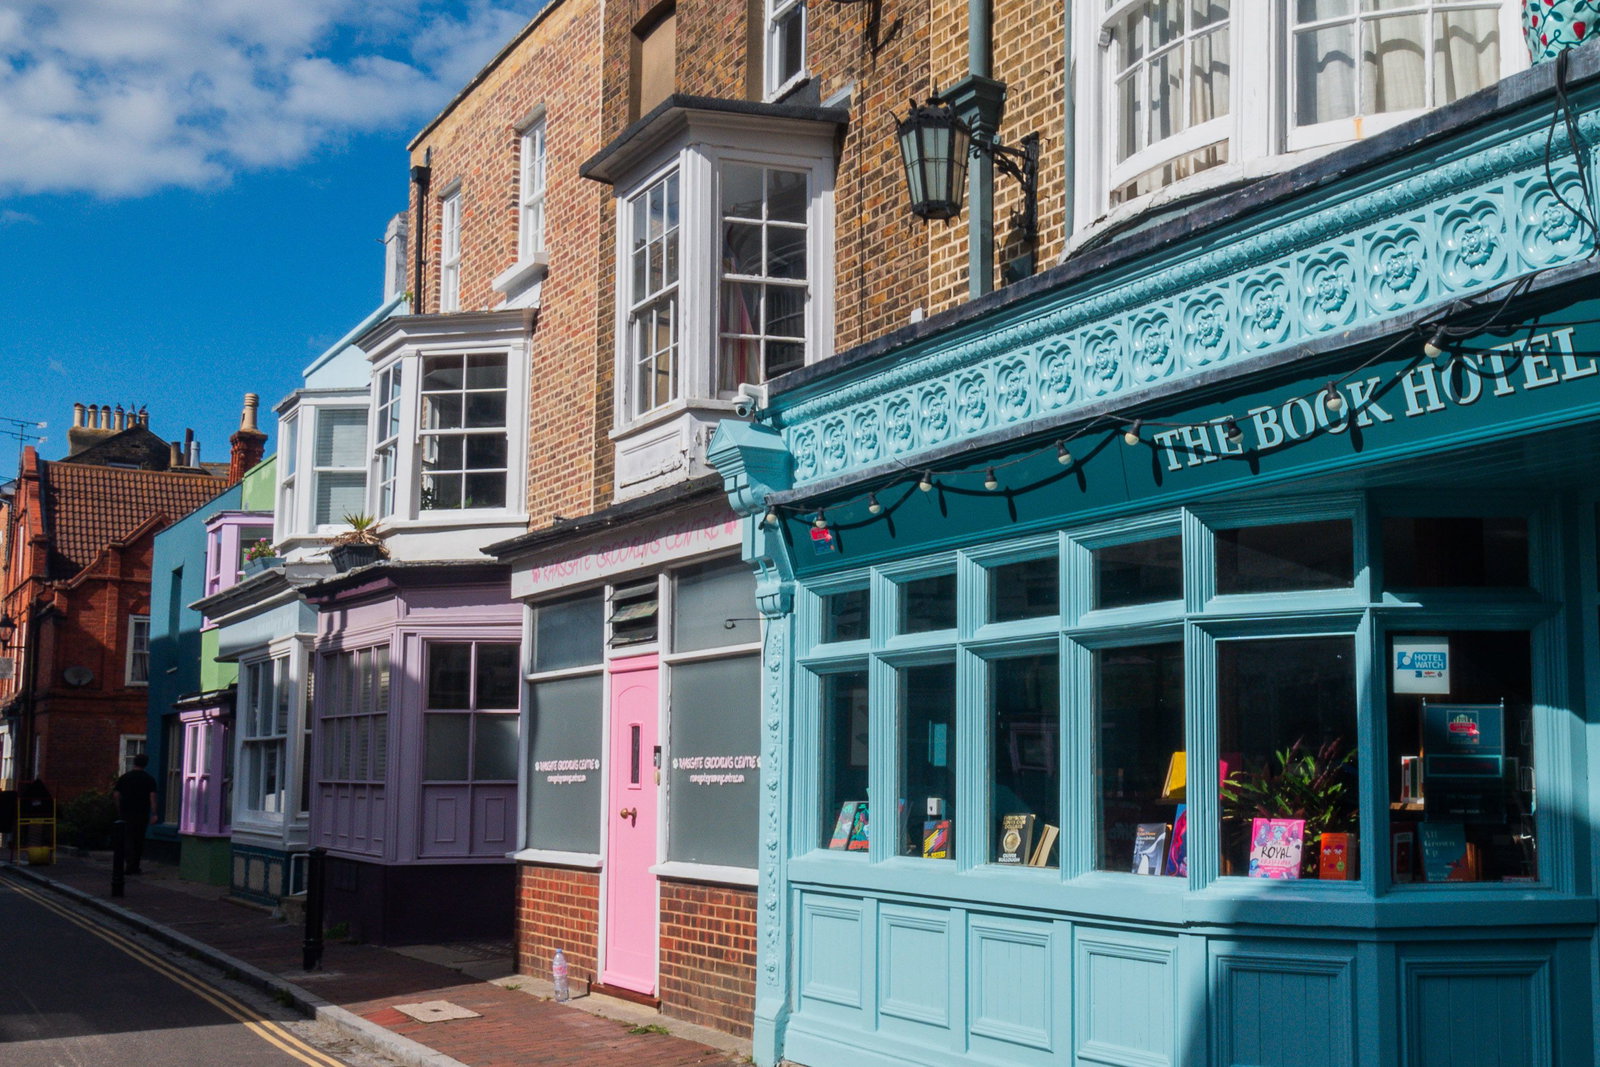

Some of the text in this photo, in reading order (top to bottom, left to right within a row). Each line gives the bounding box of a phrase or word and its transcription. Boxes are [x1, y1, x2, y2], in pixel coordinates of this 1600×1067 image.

[1153, 326, 1598, 471] THE BOOK HOTEL
[1414, 653, 1444, 661] HOTEL
[1414, 661, 1444, 669] WATCH
[1261, 845, 1292, 859] ROYAL
